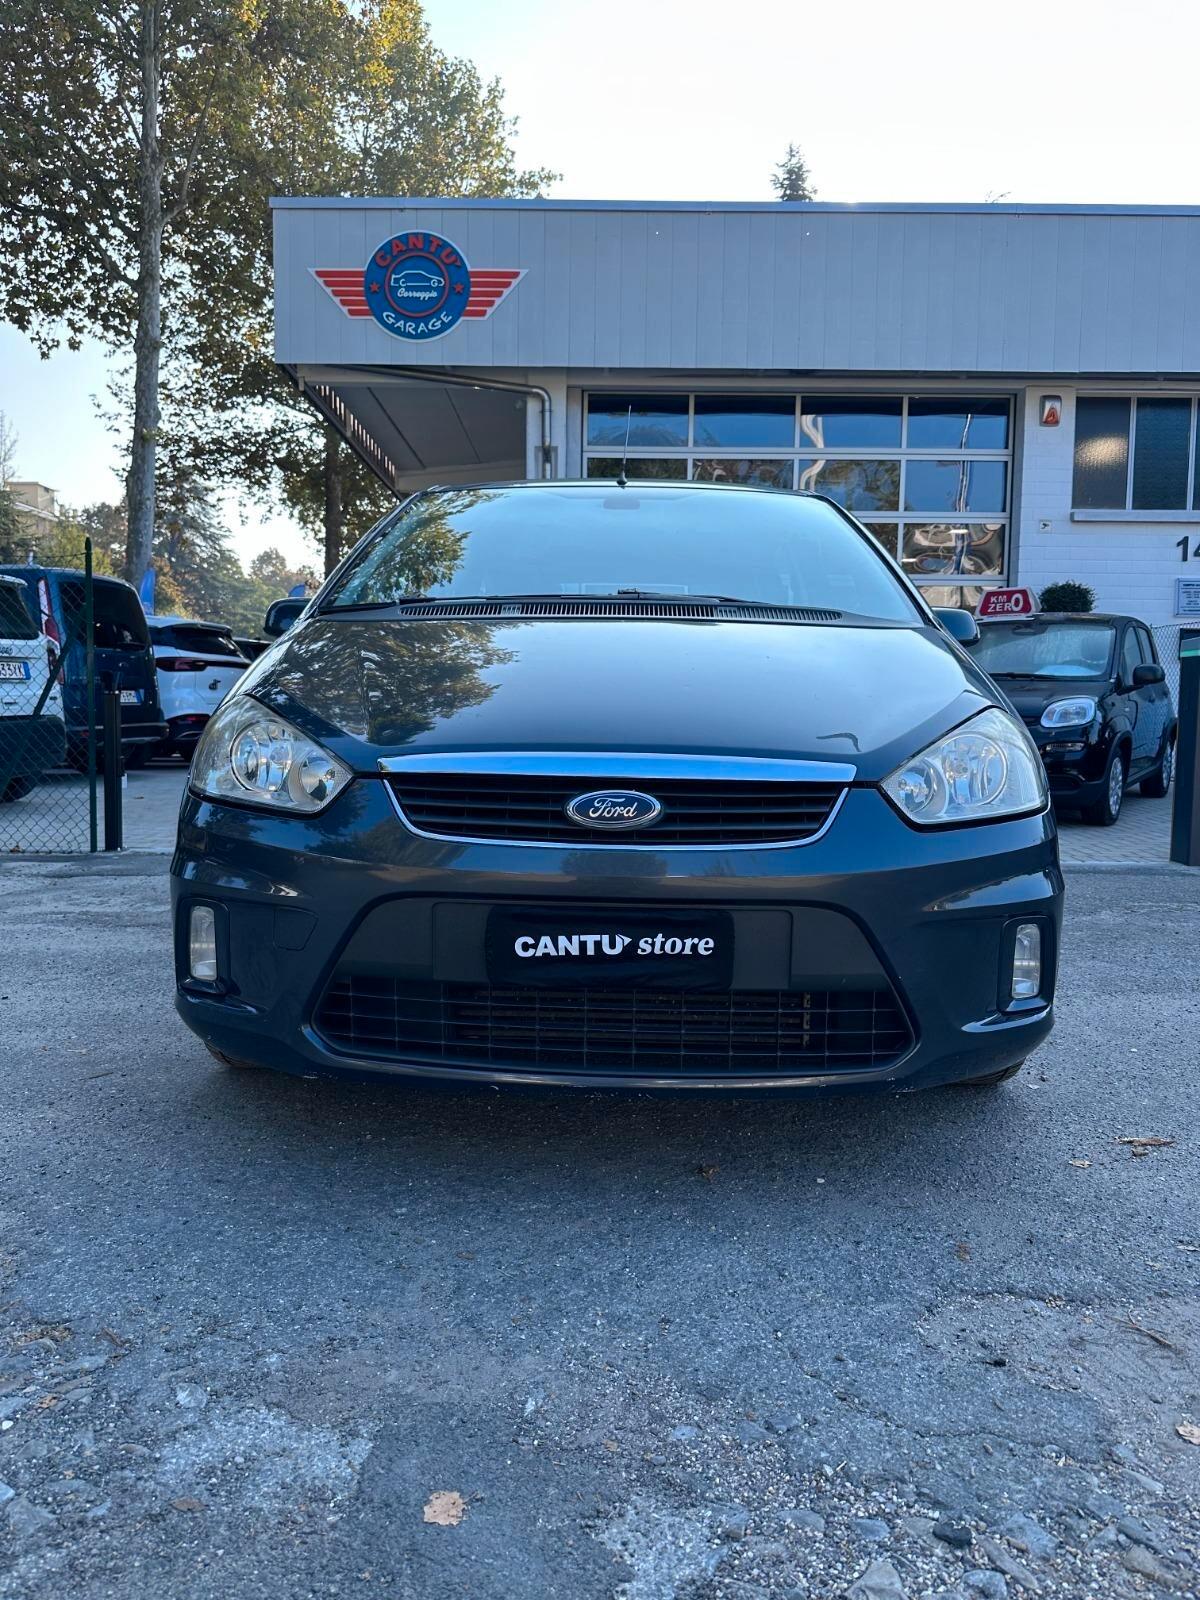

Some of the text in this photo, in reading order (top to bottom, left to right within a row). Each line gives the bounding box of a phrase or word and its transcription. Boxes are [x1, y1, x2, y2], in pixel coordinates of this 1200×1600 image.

[382, 311, 452, 335] GARAGE
[990, 595, 1007, 603] KM
[589, 798, 638, 818] Ford
[637, 933, 715, 956] store
